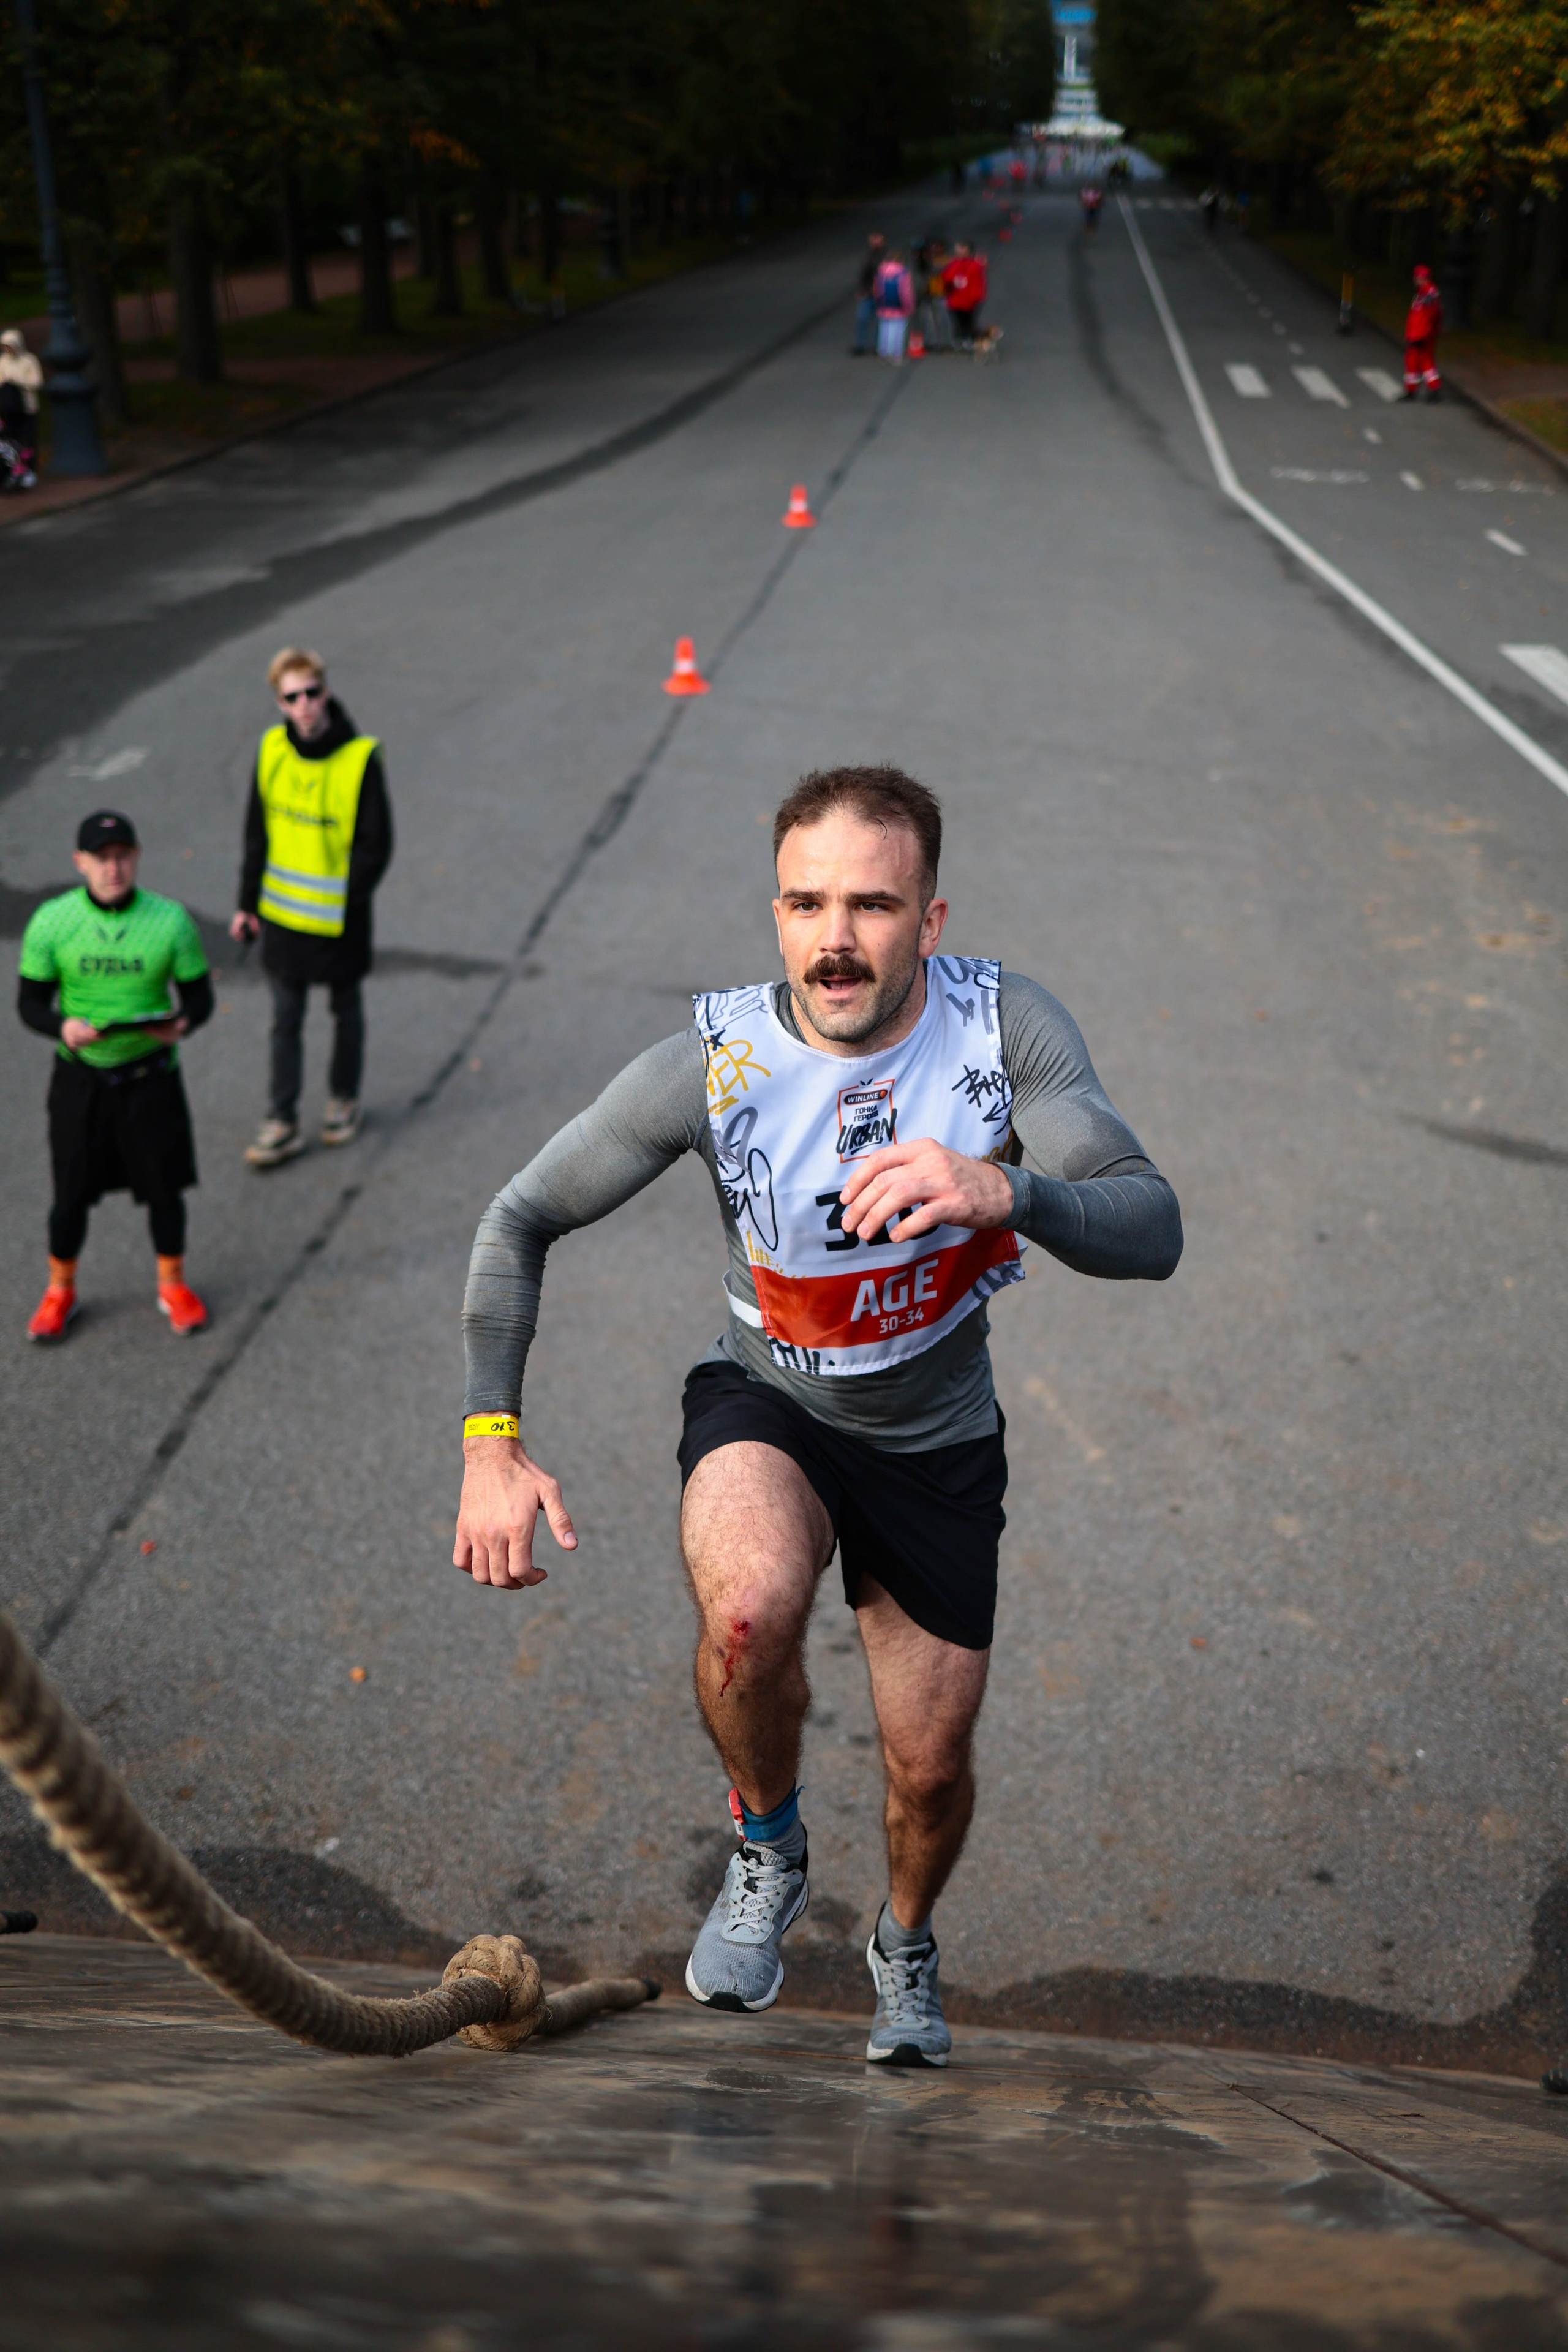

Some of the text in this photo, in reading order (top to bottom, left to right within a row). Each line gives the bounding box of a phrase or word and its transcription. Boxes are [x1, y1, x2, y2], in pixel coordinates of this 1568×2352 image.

[848, 1093, 878, 1103] WINLINE
[854, 1111, 878, 1121] ГЕРОЕВ
[856, 1106, 877, 1115] ГОНКА
[837, 1109, 897, 1155] URBAN
[851, 1258, 939, 1322] AGE
[879, 1306, 924, 1334] 30-34
